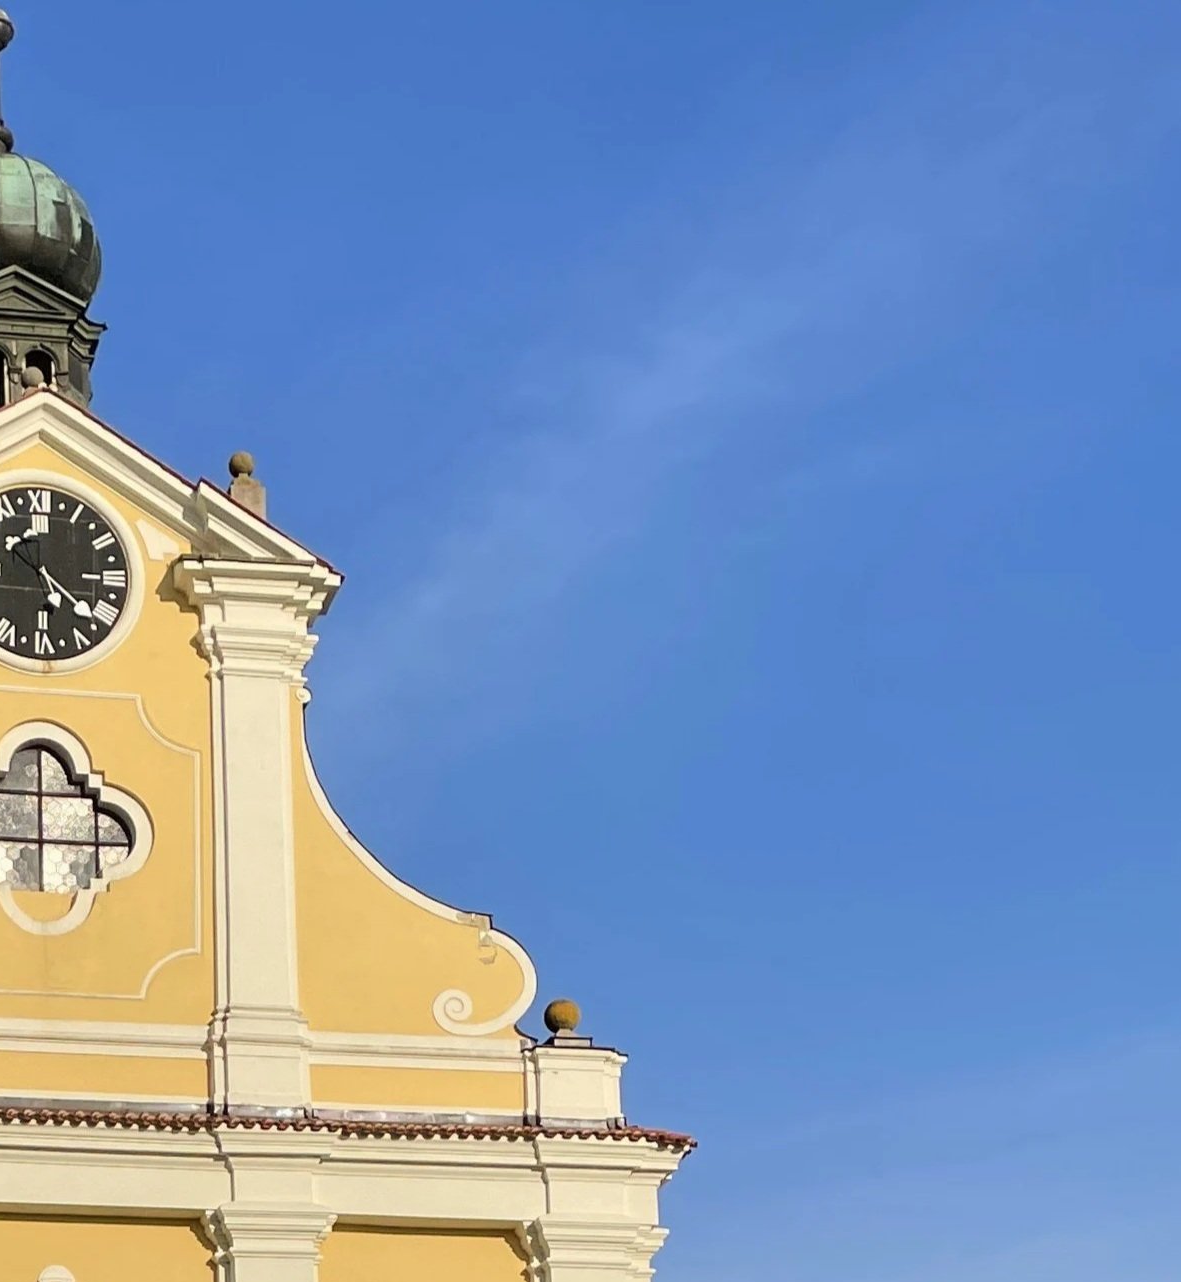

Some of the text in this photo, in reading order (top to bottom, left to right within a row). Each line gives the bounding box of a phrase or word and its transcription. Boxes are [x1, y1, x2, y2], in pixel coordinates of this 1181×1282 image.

[28, 490, 51, 513] XII
[92, 532, 115, 550] II
[34, 631, 55, 654] VI
[73, 627, 91, 650] V
